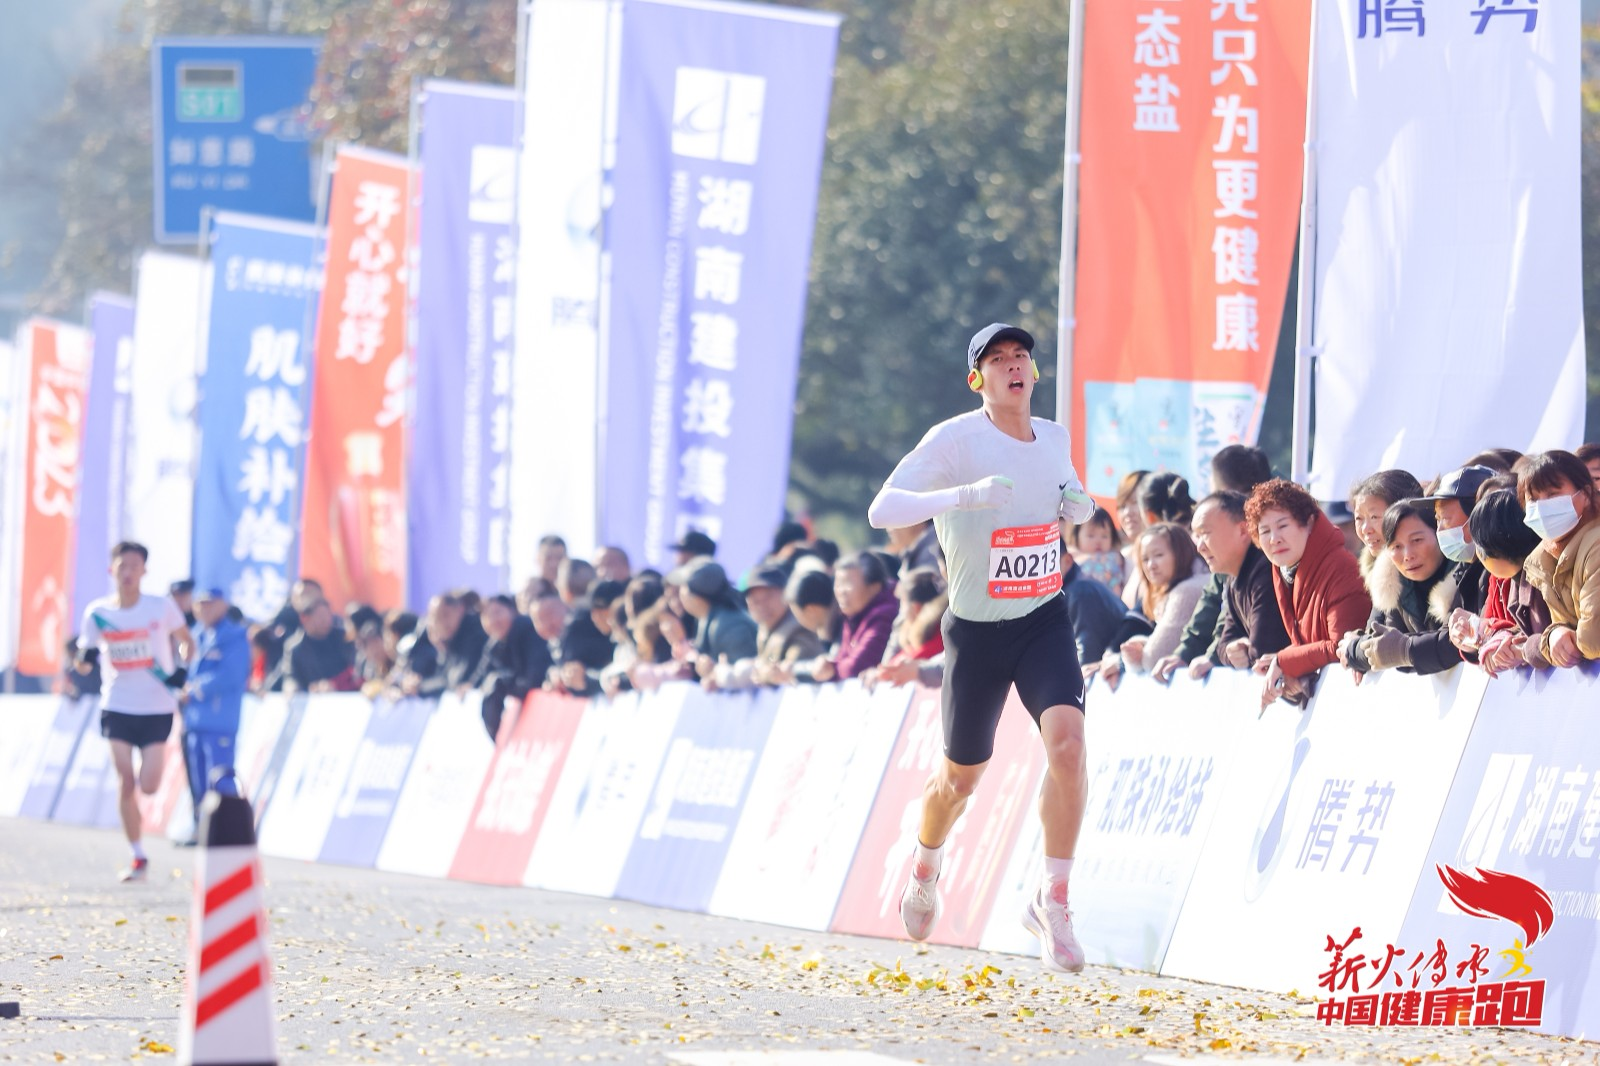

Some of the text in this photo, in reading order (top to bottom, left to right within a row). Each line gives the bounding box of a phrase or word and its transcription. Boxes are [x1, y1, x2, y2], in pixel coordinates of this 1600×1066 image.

[994, 549, 1057, 579] A0213
[1096, 754, 1213, 838] 肌肤补给站
[1295, 779, 1395, 875] 腾势
